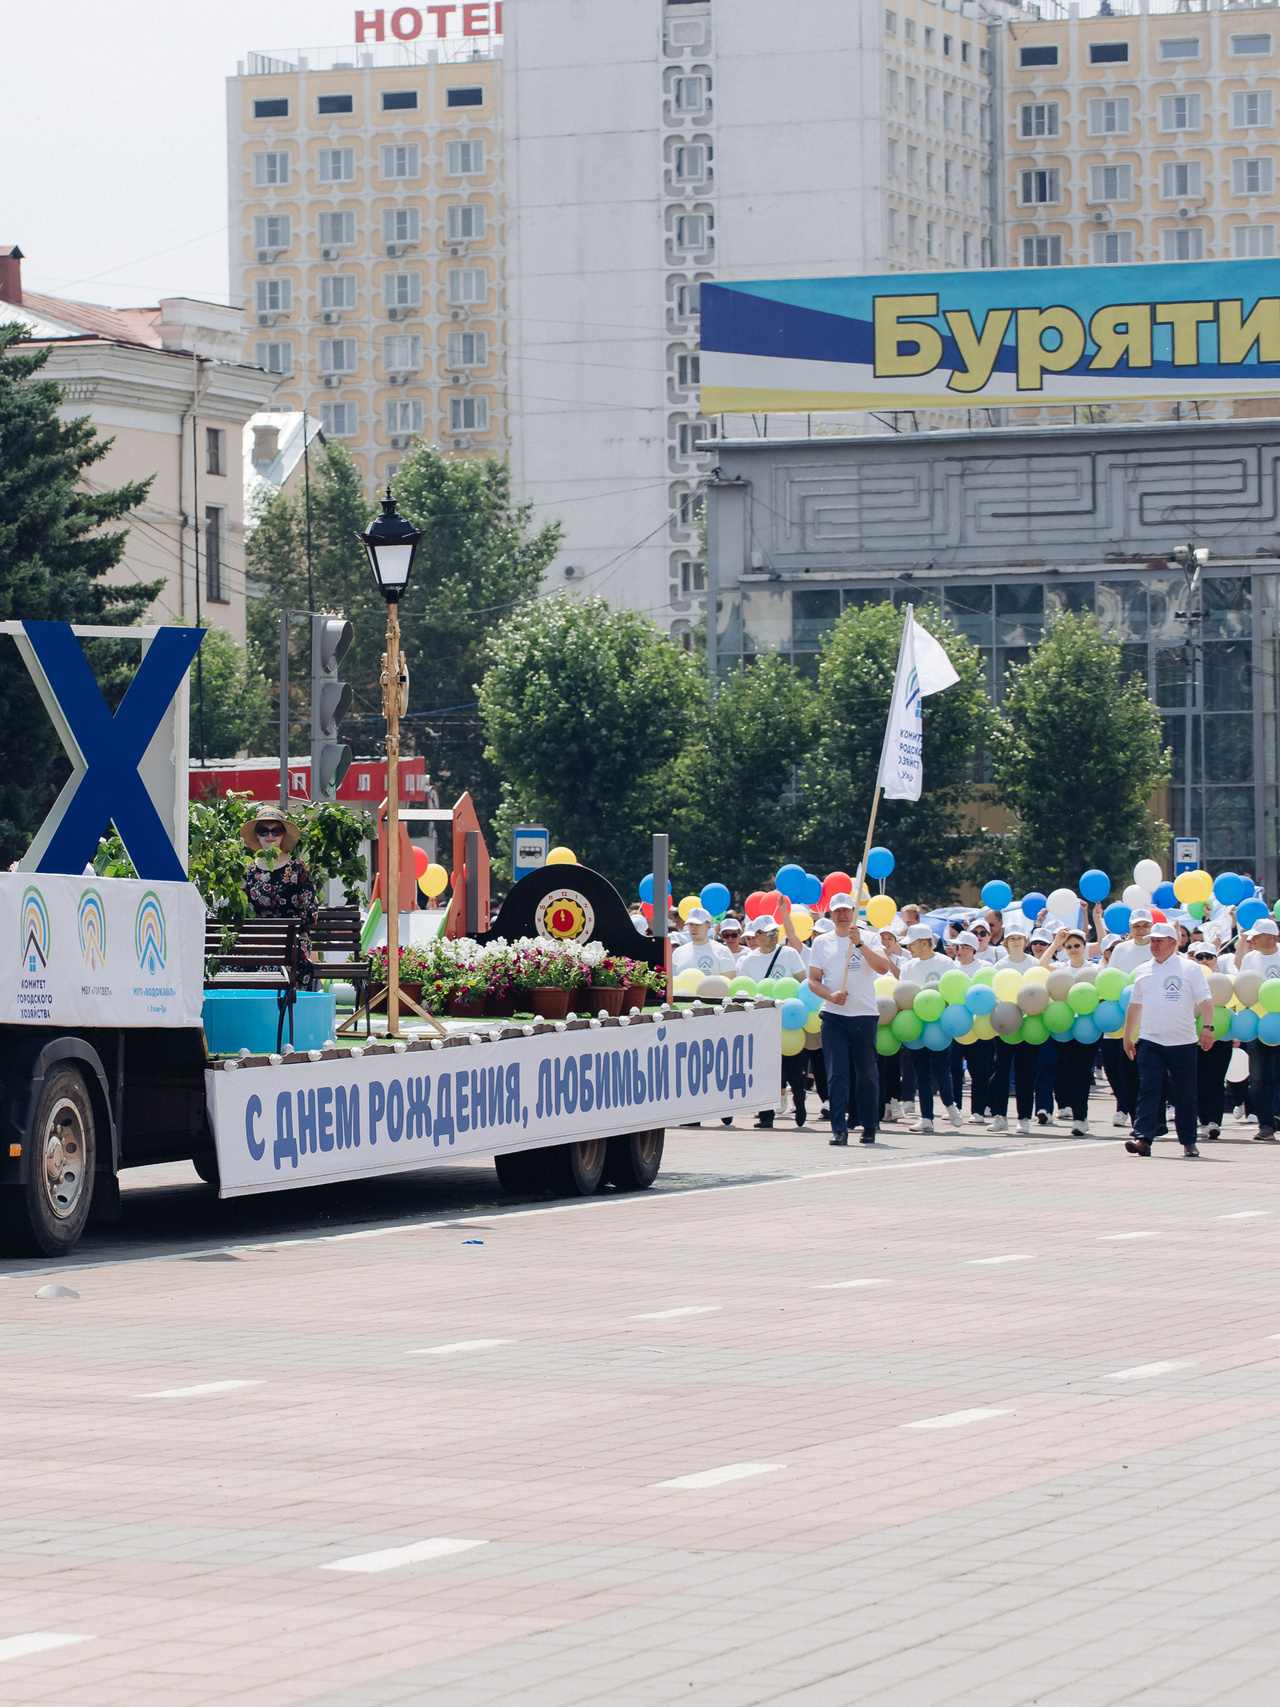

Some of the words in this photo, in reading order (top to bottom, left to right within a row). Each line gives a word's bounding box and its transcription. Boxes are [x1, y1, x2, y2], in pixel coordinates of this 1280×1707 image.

[872, 293, 1280, 393] Буряти
[21, 979, 46, 989] КОМИТЕТ
[245, 1094, 266, 1161] С
[273, 1084, 361, 1171] ДНЕМ
[369, 1062, 529, 1147] РОЖДЕНИЯ,
[536, 1026, 670, 1119] ЛЮБИМЫЙ
[675, 1033, 754, 1100] ГОРОД!
